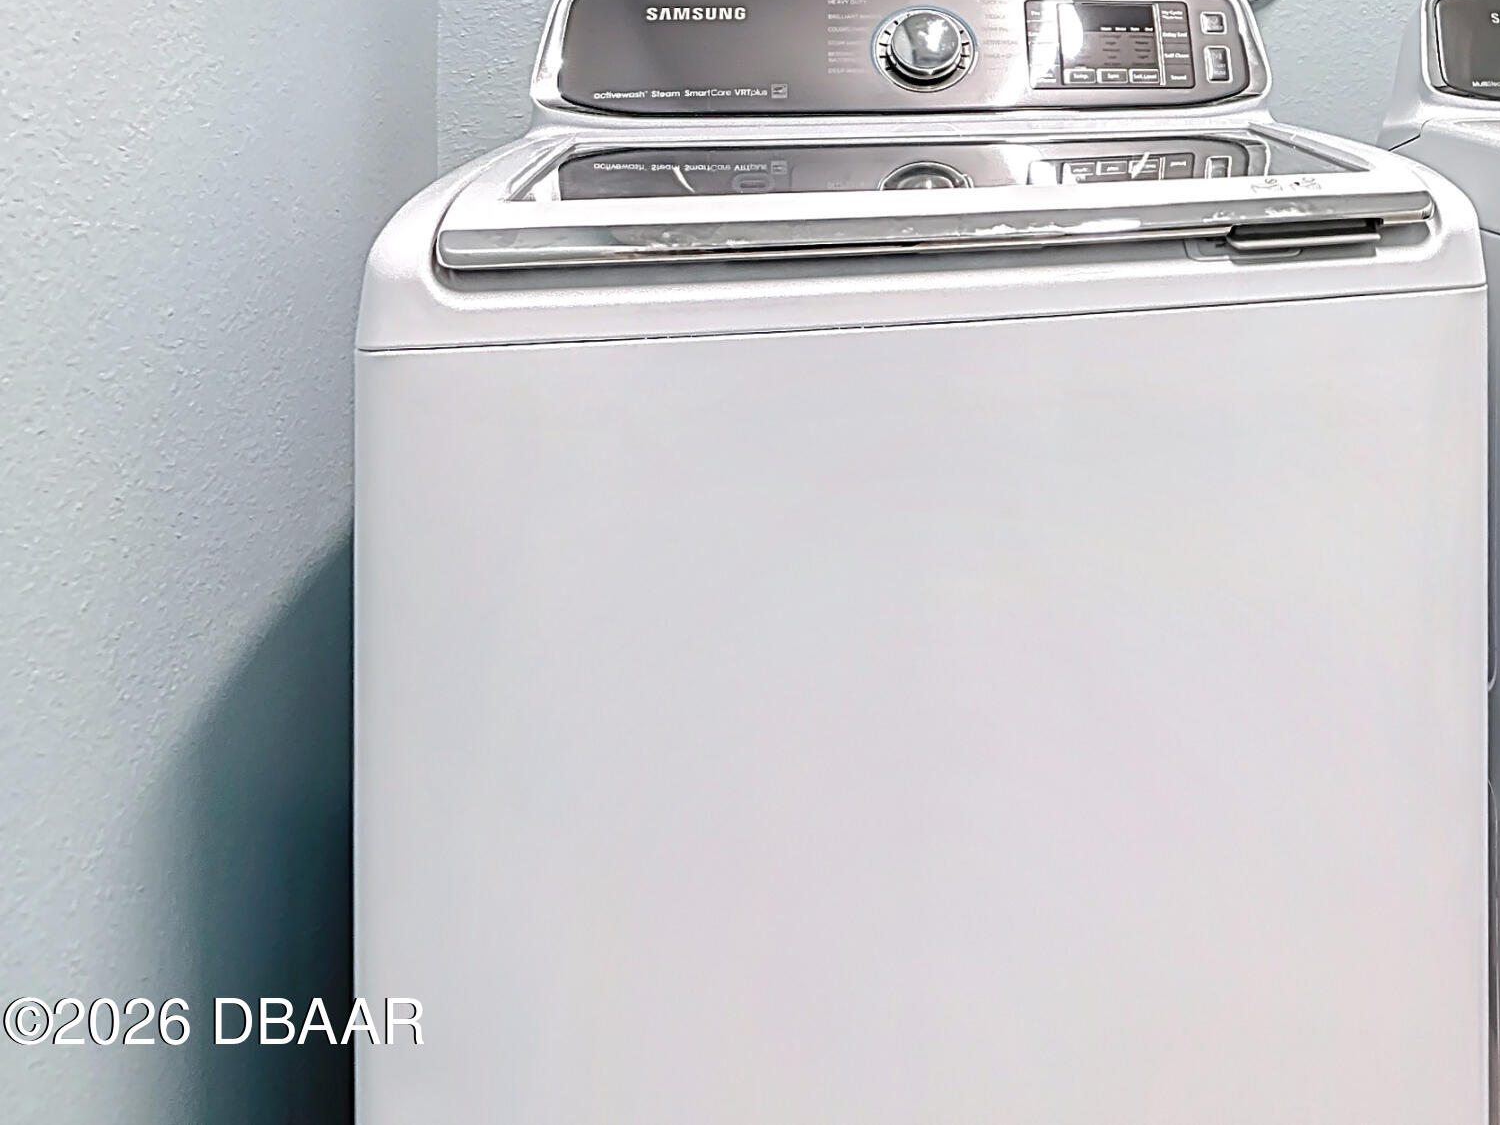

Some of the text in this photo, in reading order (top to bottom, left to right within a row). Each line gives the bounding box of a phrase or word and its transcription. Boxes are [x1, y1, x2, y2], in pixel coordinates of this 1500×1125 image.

[645, 7, 747, 21] SAMSUNG
[593, 88, 768, 100] activewash Steam SmartCare VRTplus
